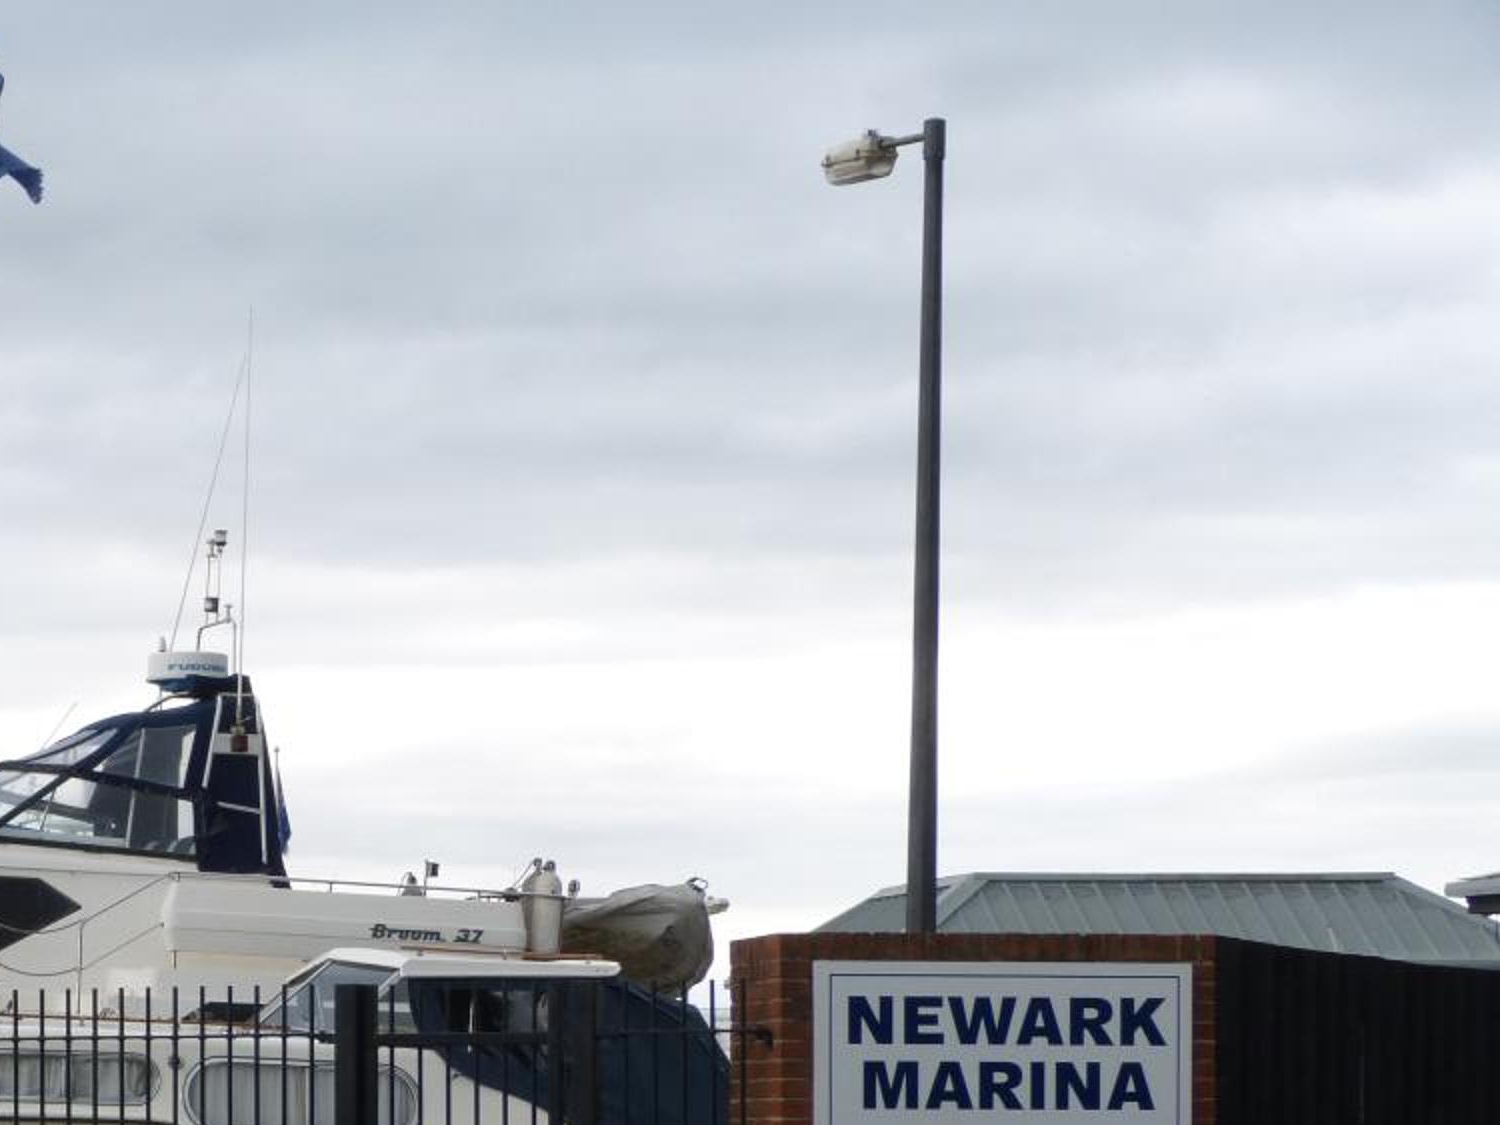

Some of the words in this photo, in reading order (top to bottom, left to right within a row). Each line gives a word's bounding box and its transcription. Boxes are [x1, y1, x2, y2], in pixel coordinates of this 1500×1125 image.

[453, 928, 484, 944] 37
[847, 996, 1166, 1046] NEWARK
[863, 1061, 1155, 1110] MARINA
